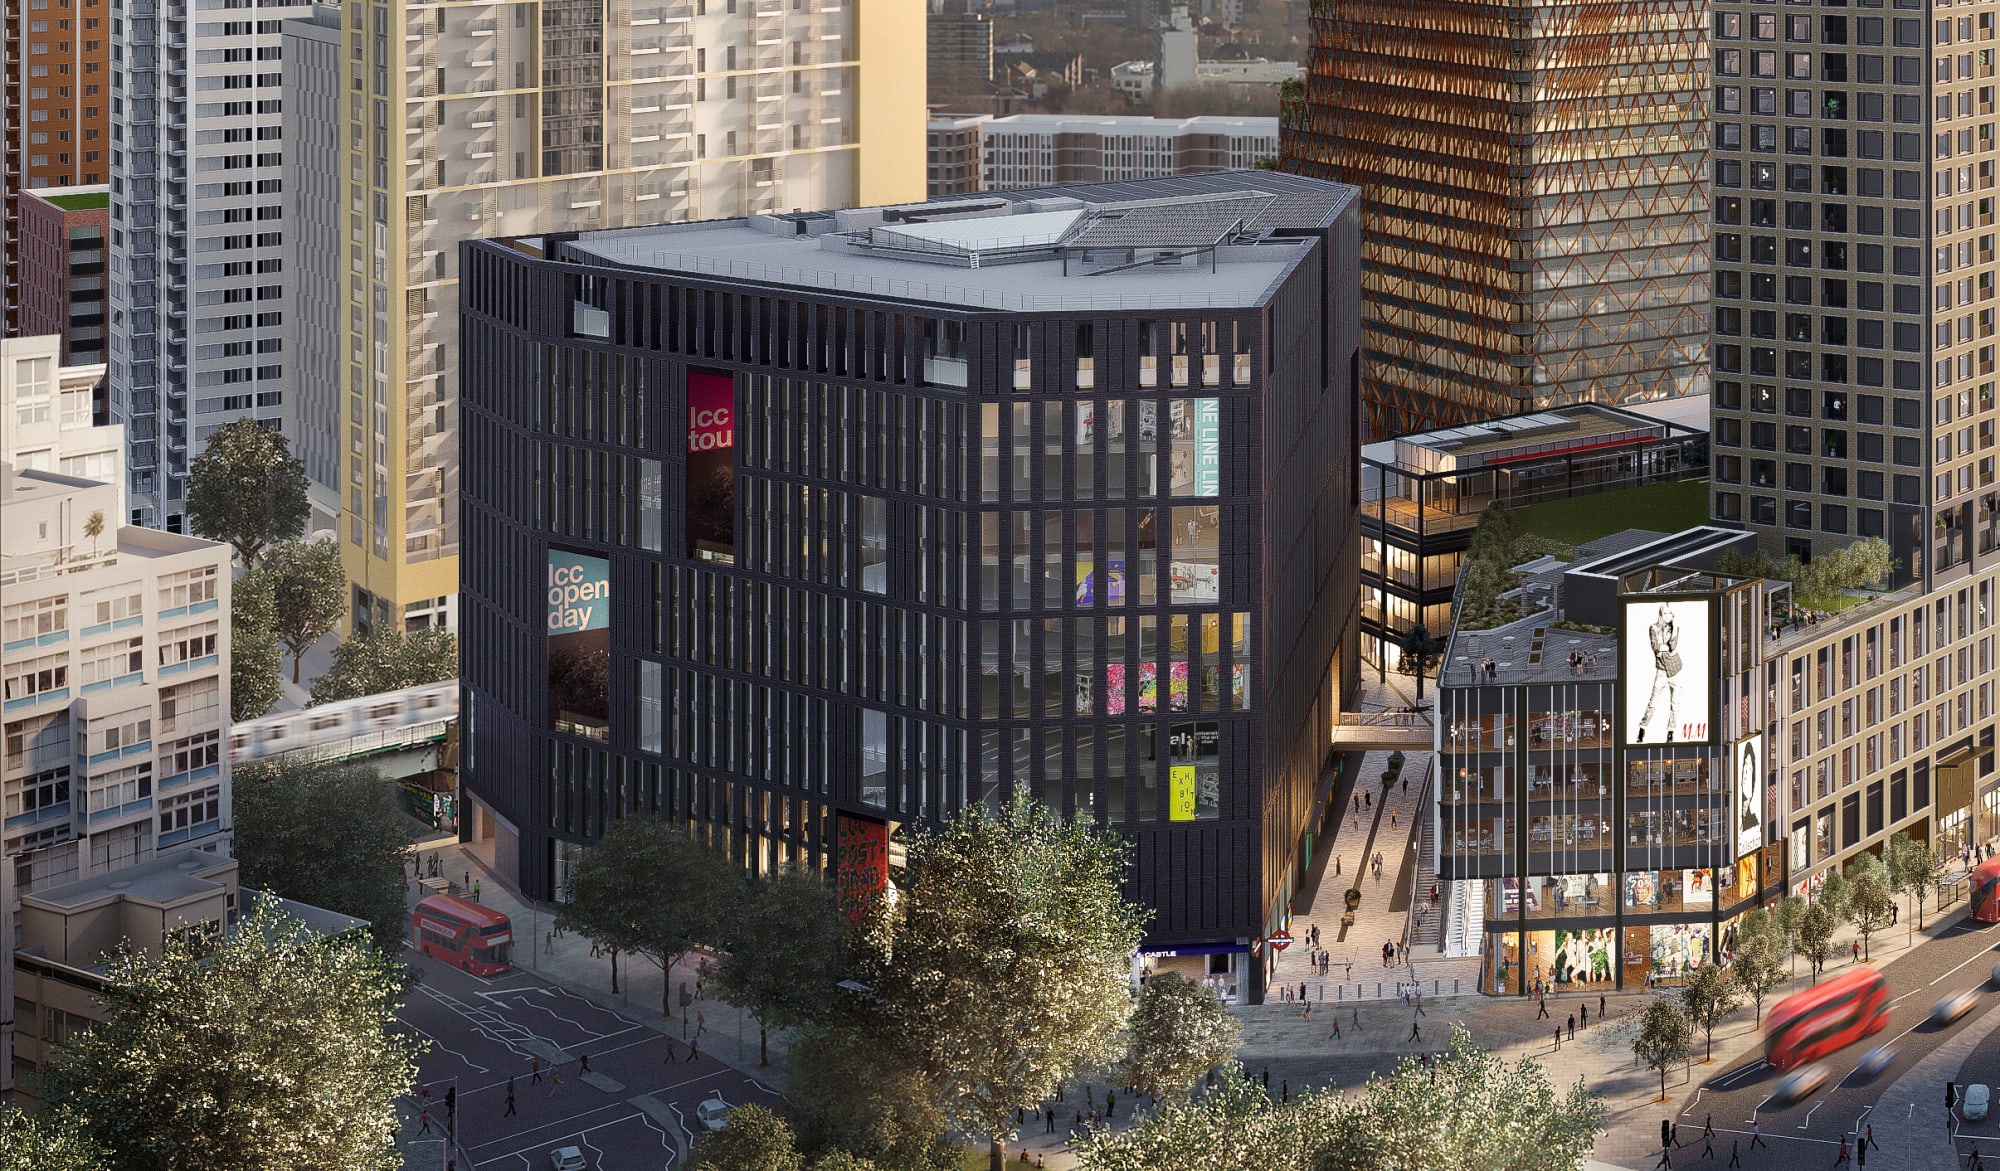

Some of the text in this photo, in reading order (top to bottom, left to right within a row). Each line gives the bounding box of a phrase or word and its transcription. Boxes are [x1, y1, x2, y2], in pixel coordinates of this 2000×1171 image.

[690, 406, 729, 429] lcc
[688, 430, 732, 450] tou
[1202, 400, 1218, 497] NE LINE LIN
[548, 563, 584, 586] lcc
[548, 580, 609, 609] open
[548, 605, 592, 631] day
[1144, 950, 1177, 958] CASTLE
